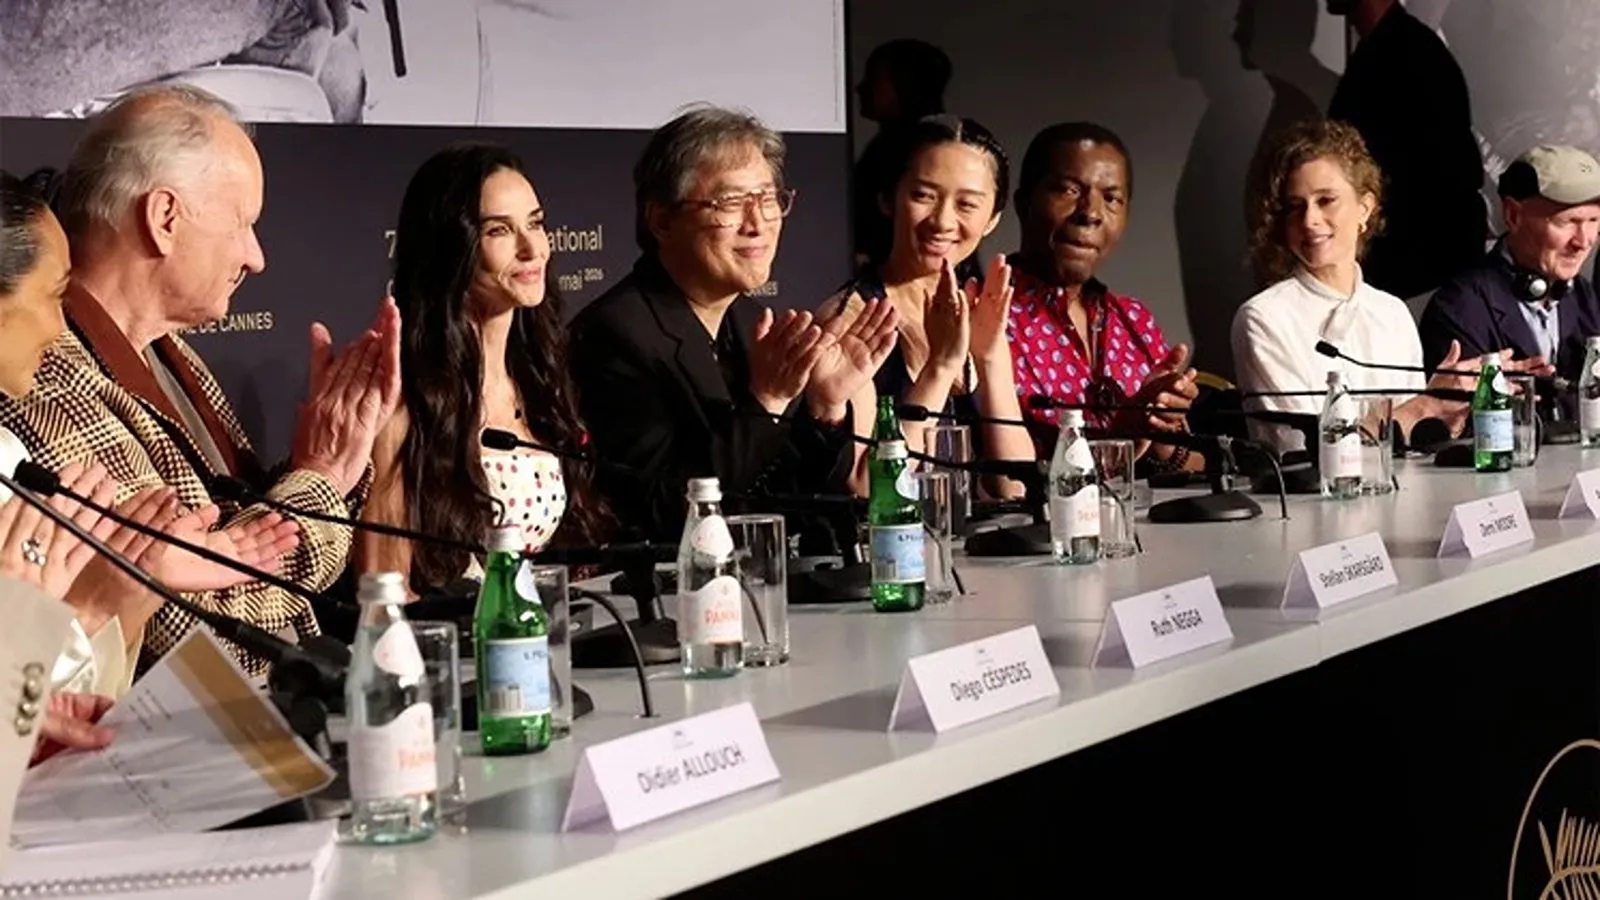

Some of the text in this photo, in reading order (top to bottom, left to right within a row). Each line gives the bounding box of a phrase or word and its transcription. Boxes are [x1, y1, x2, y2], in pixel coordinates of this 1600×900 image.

[220, 311, 274, 333] CANNES
[1171, 608, 1203, 630] NEGGA
[950, 661, 1032, 702] Diego CÉSPEDES
[637, 742, 745, 794] Didier ALLOUCH
